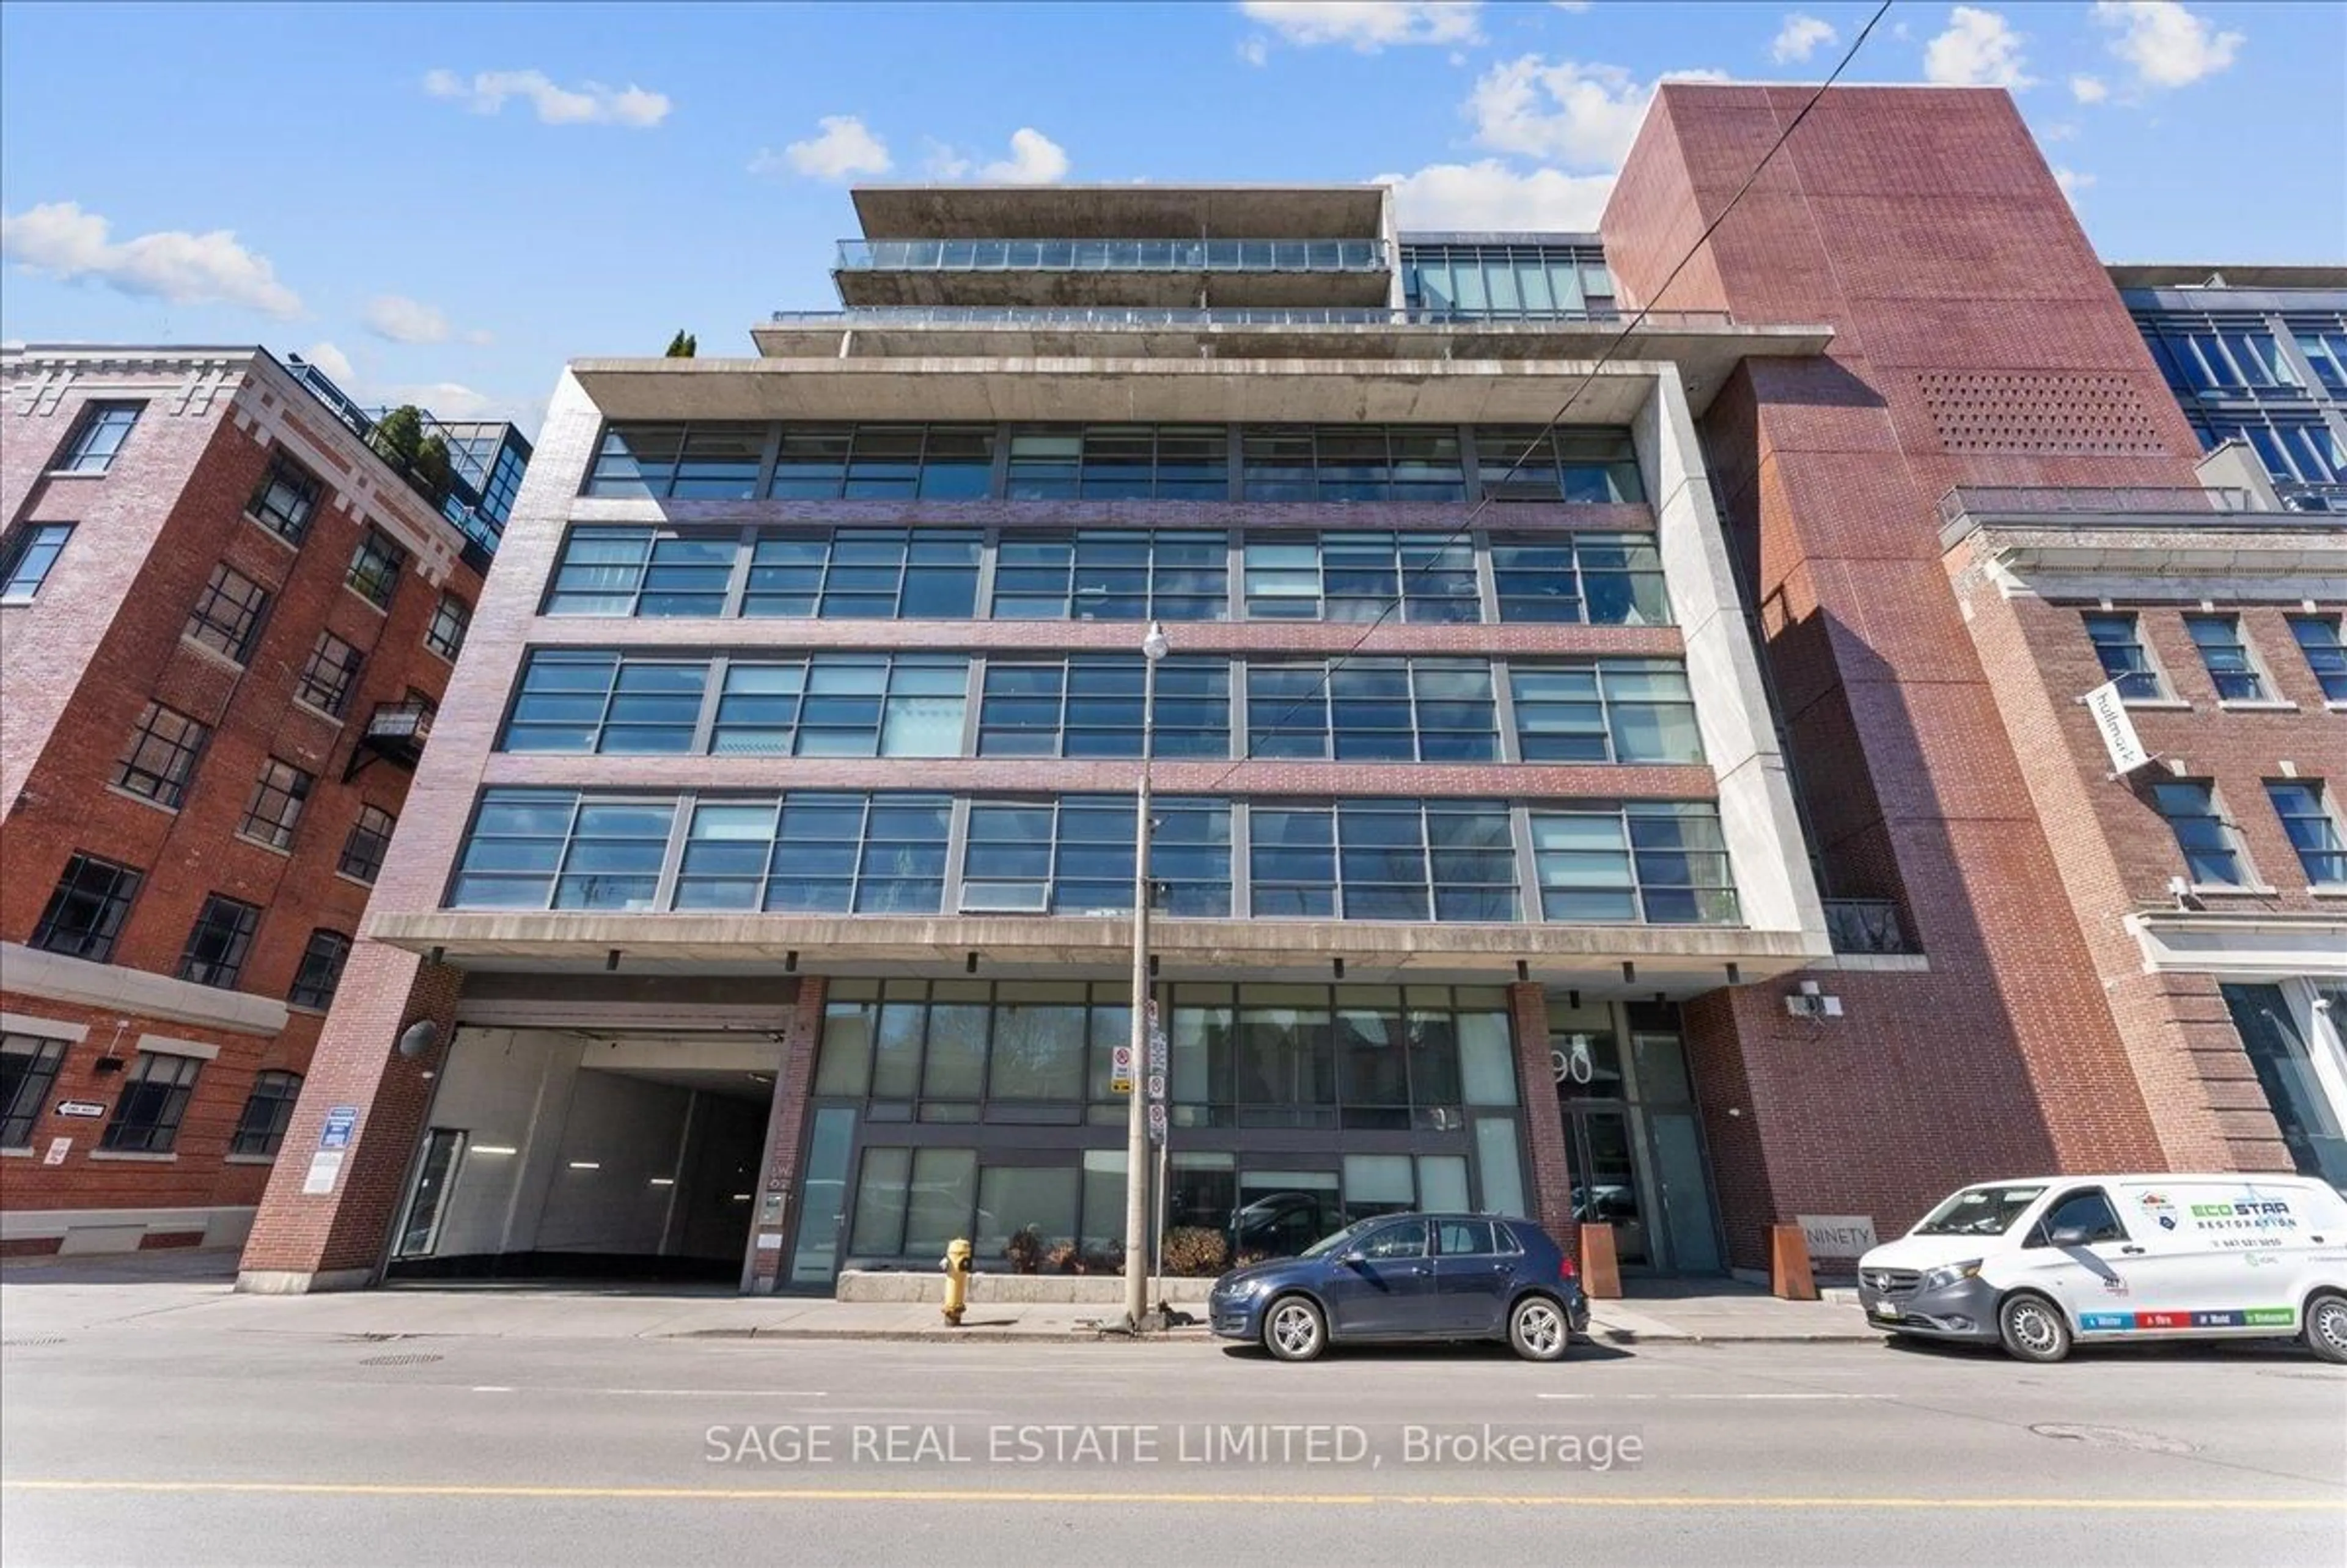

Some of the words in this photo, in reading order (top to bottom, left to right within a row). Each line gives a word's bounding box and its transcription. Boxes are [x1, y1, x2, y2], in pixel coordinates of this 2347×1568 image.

[1551, 1050, 1593, 1084] 90
[2190, 1204, 2232, 1218] ECO
[2197, 1218, 2297, 1230] RESTORATION
[1807, 1227, 1869, 1245] NINETY
